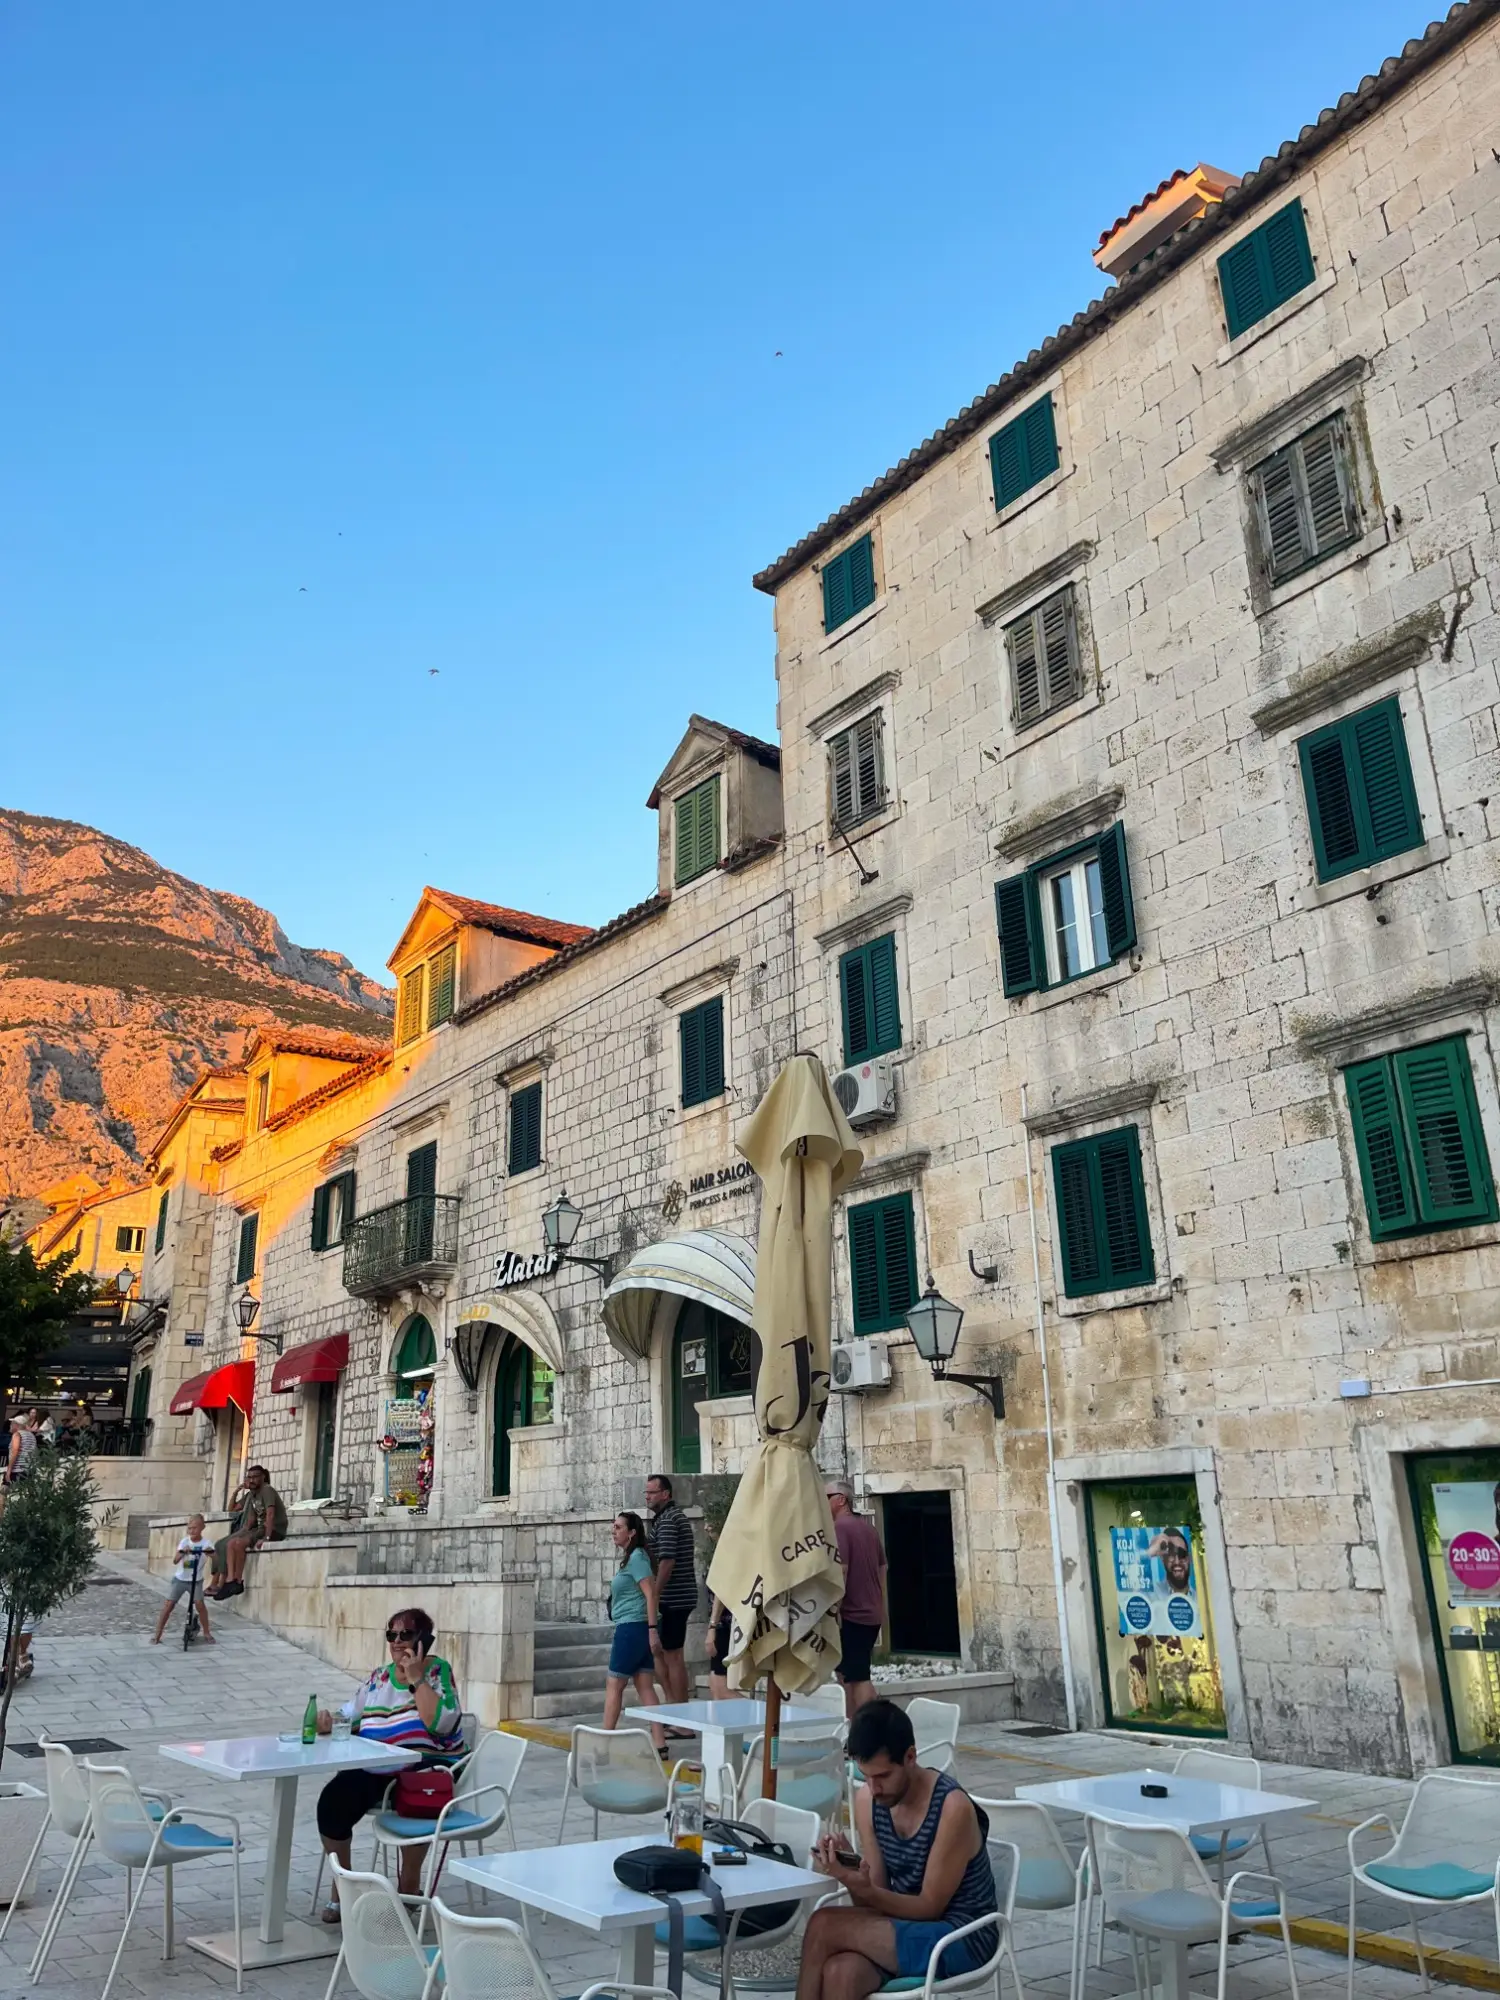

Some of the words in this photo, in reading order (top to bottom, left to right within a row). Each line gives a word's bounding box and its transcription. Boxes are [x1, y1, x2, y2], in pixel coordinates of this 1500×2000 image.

[690, 1173, 715, 1193] HAIR
[717, 1161, 755, 1183] SALON
[689, 1193, 720, 1210] PRINCESS
[729, 1183, 755, 1200] PRINCE
[494, 1251, 558, 1288] Zlatar
[1116, 1539, 1136, 1551] KOJI
